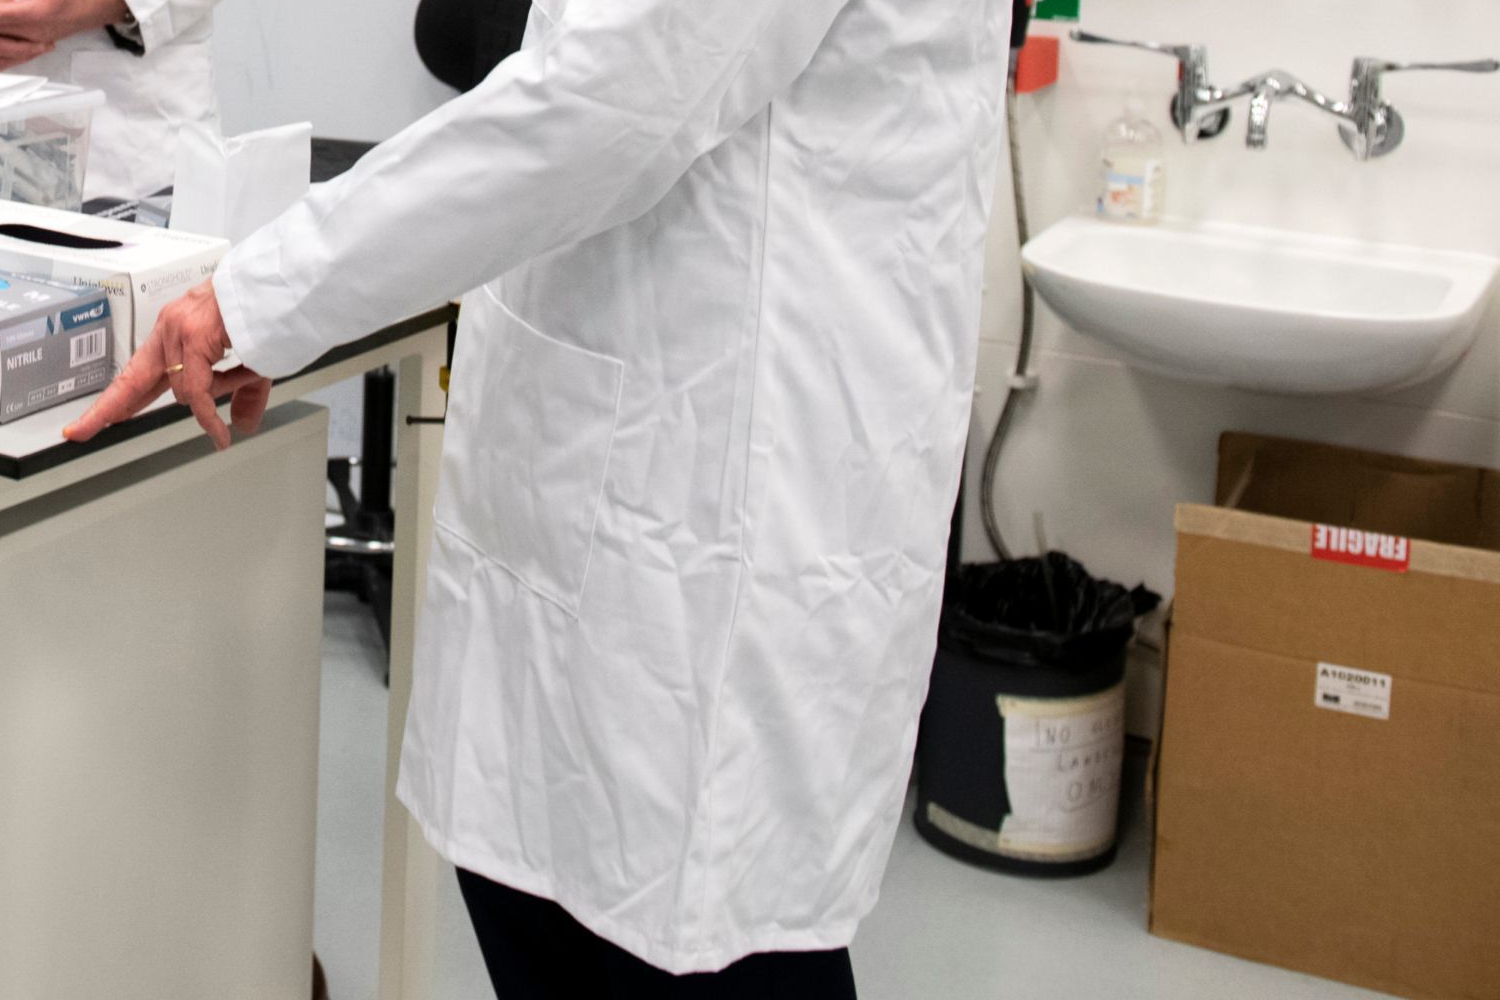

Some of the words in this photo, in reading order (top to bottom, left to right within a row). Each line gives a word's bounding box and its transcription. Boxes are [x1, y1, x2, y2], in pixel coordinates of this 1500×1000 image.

[72, 310, 90, 323] VWR
[6, 347, 43, 371] NITRILE
[1315, 523, 1408, 561] FRAGILE
